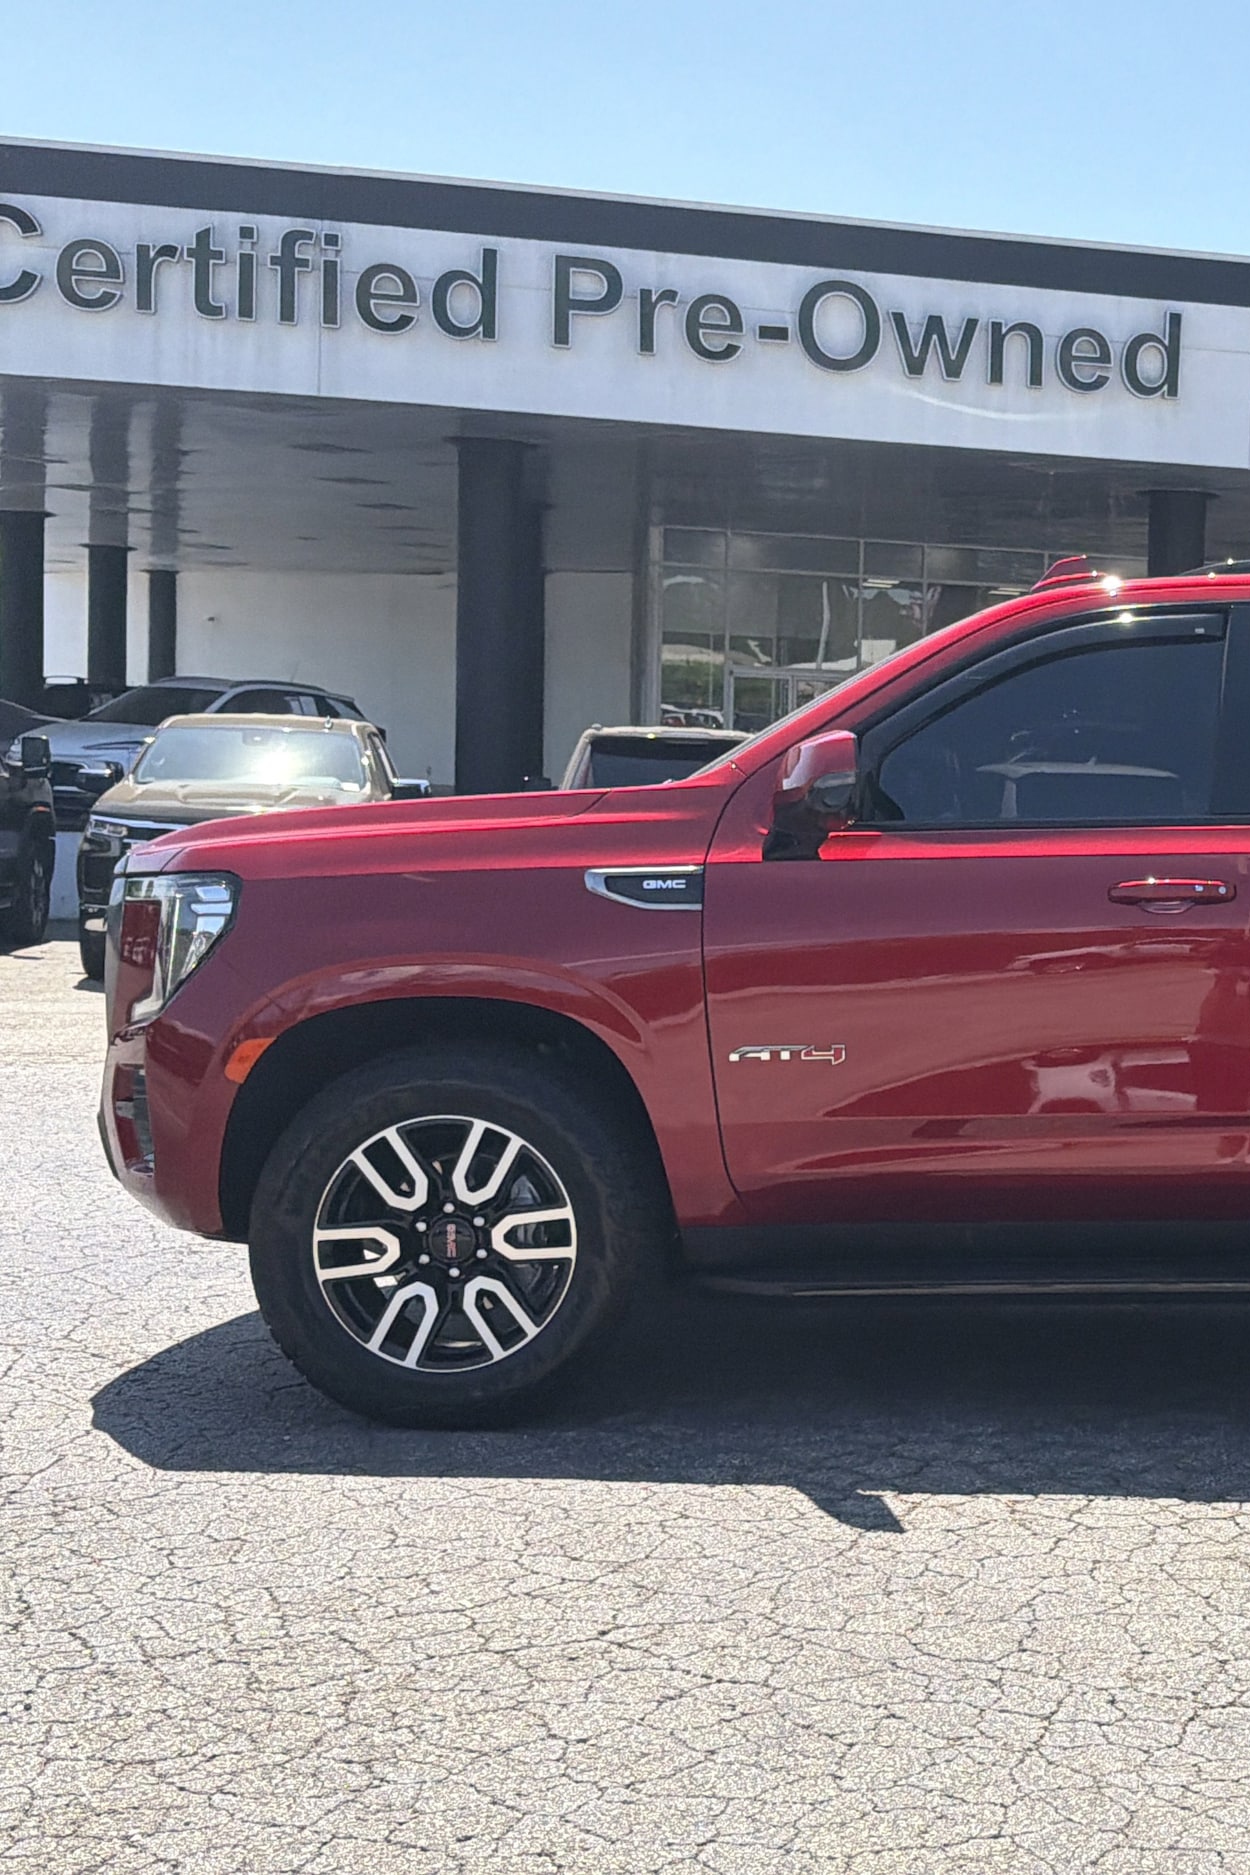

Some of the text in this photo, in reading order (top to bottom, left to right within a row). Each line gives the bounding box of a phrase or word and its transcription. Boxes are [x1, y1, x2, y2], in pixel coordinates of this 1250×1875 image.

[551, 253, 1182, 400] Pre-Owned
[642, 879, 687, 889] GMC
[728, 1044, 846, 1066] AT4
[446, 1223, 457, 1258] GMC
